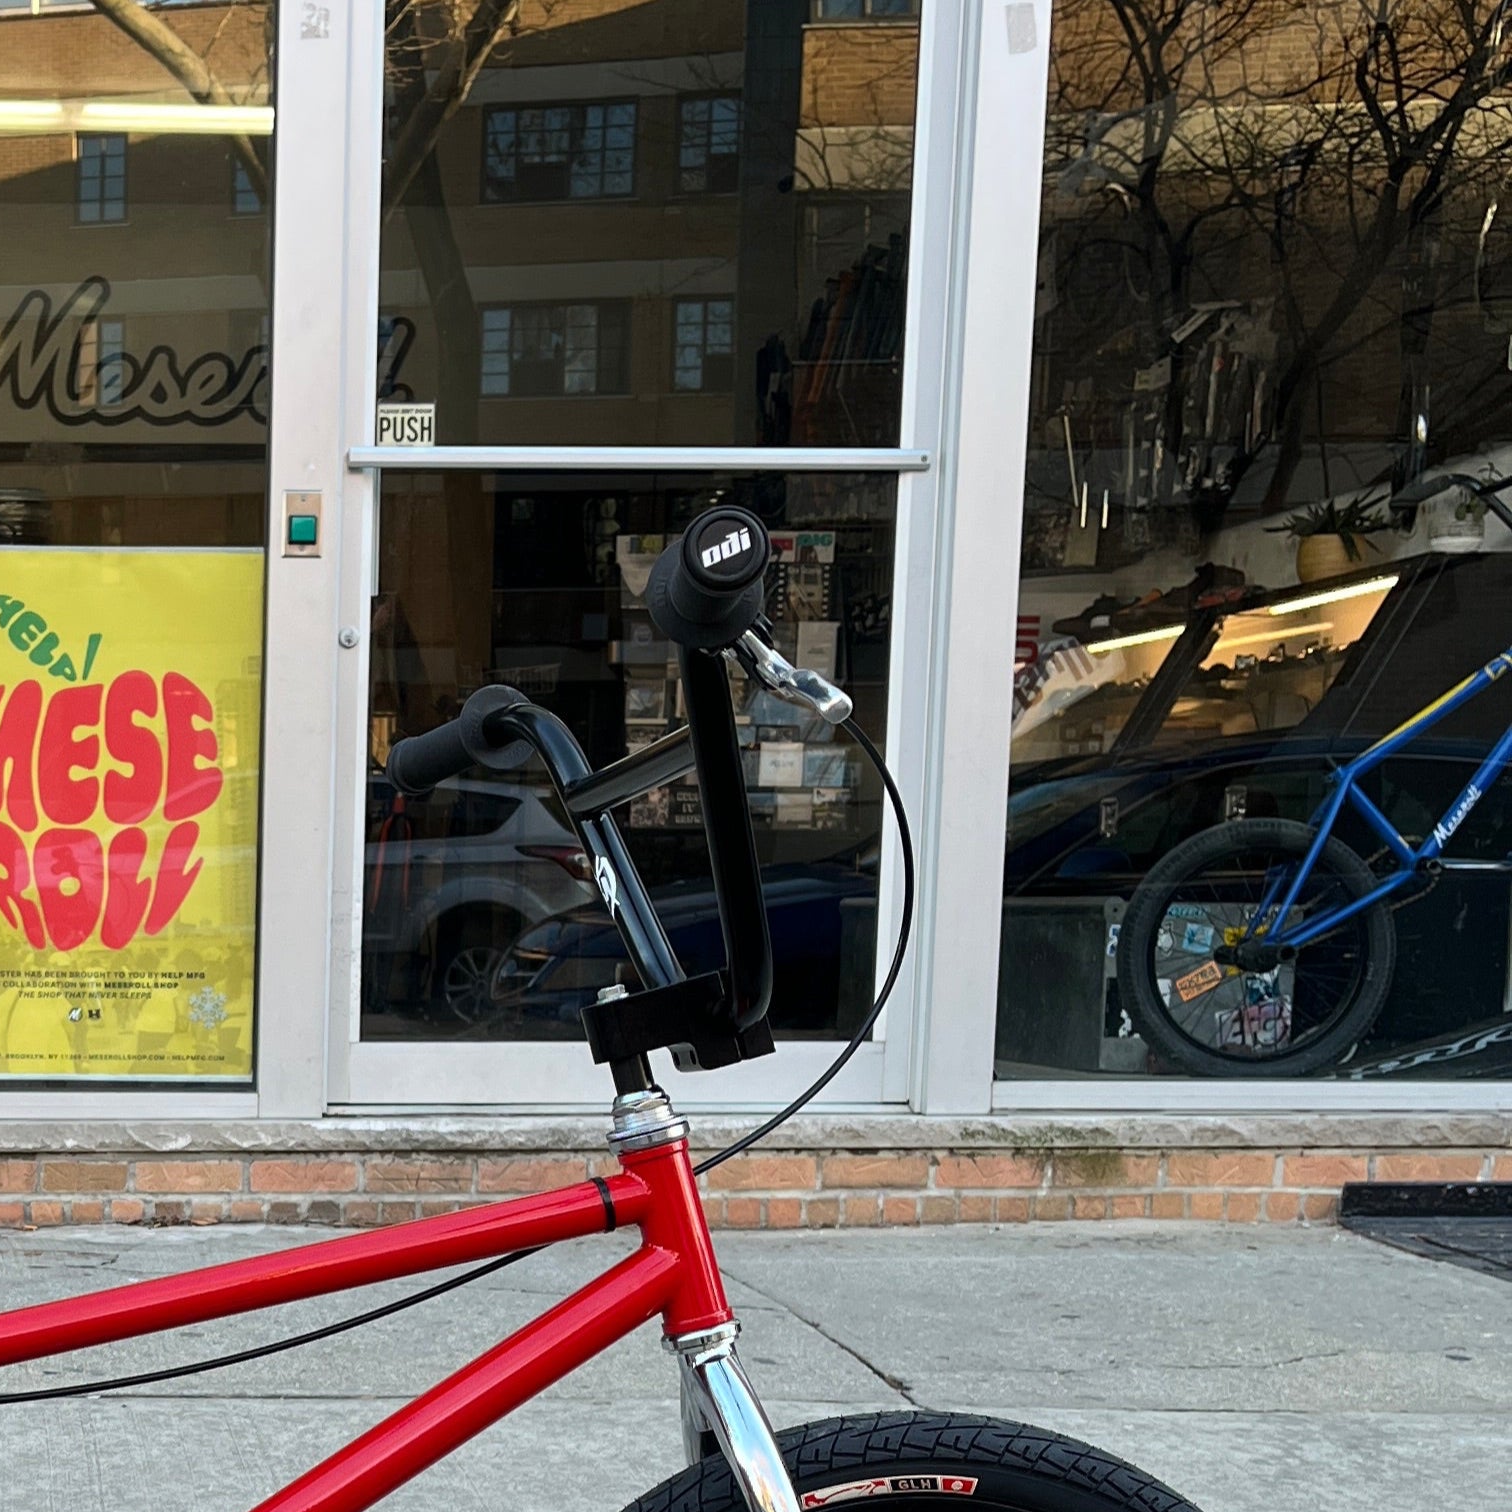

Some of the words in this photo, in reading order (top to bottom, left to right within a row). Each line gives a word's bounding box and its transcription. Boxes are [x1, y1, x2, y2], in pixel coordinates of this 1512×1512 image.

[379, 416, 433, 443] PUSH
[701, 527, 753, 569] odi
[24, 970, 42, 978] HAS
[44, 970, 67, 979] BEEN
[69, 971, 110, 979] BROUGHT
[114, 971, 126, 979] TO
[128, 971, 145, 979] YOU
[161, 972, 184, 980] HELP
[186, 972, 206, 980] MFG
[2, 981, 77, 989] COLLABORATION
[37, 991, 62, 999] SHOP
[64, 991, 86, 999] THAT
[898, 1478, 932, 1491] GLH
